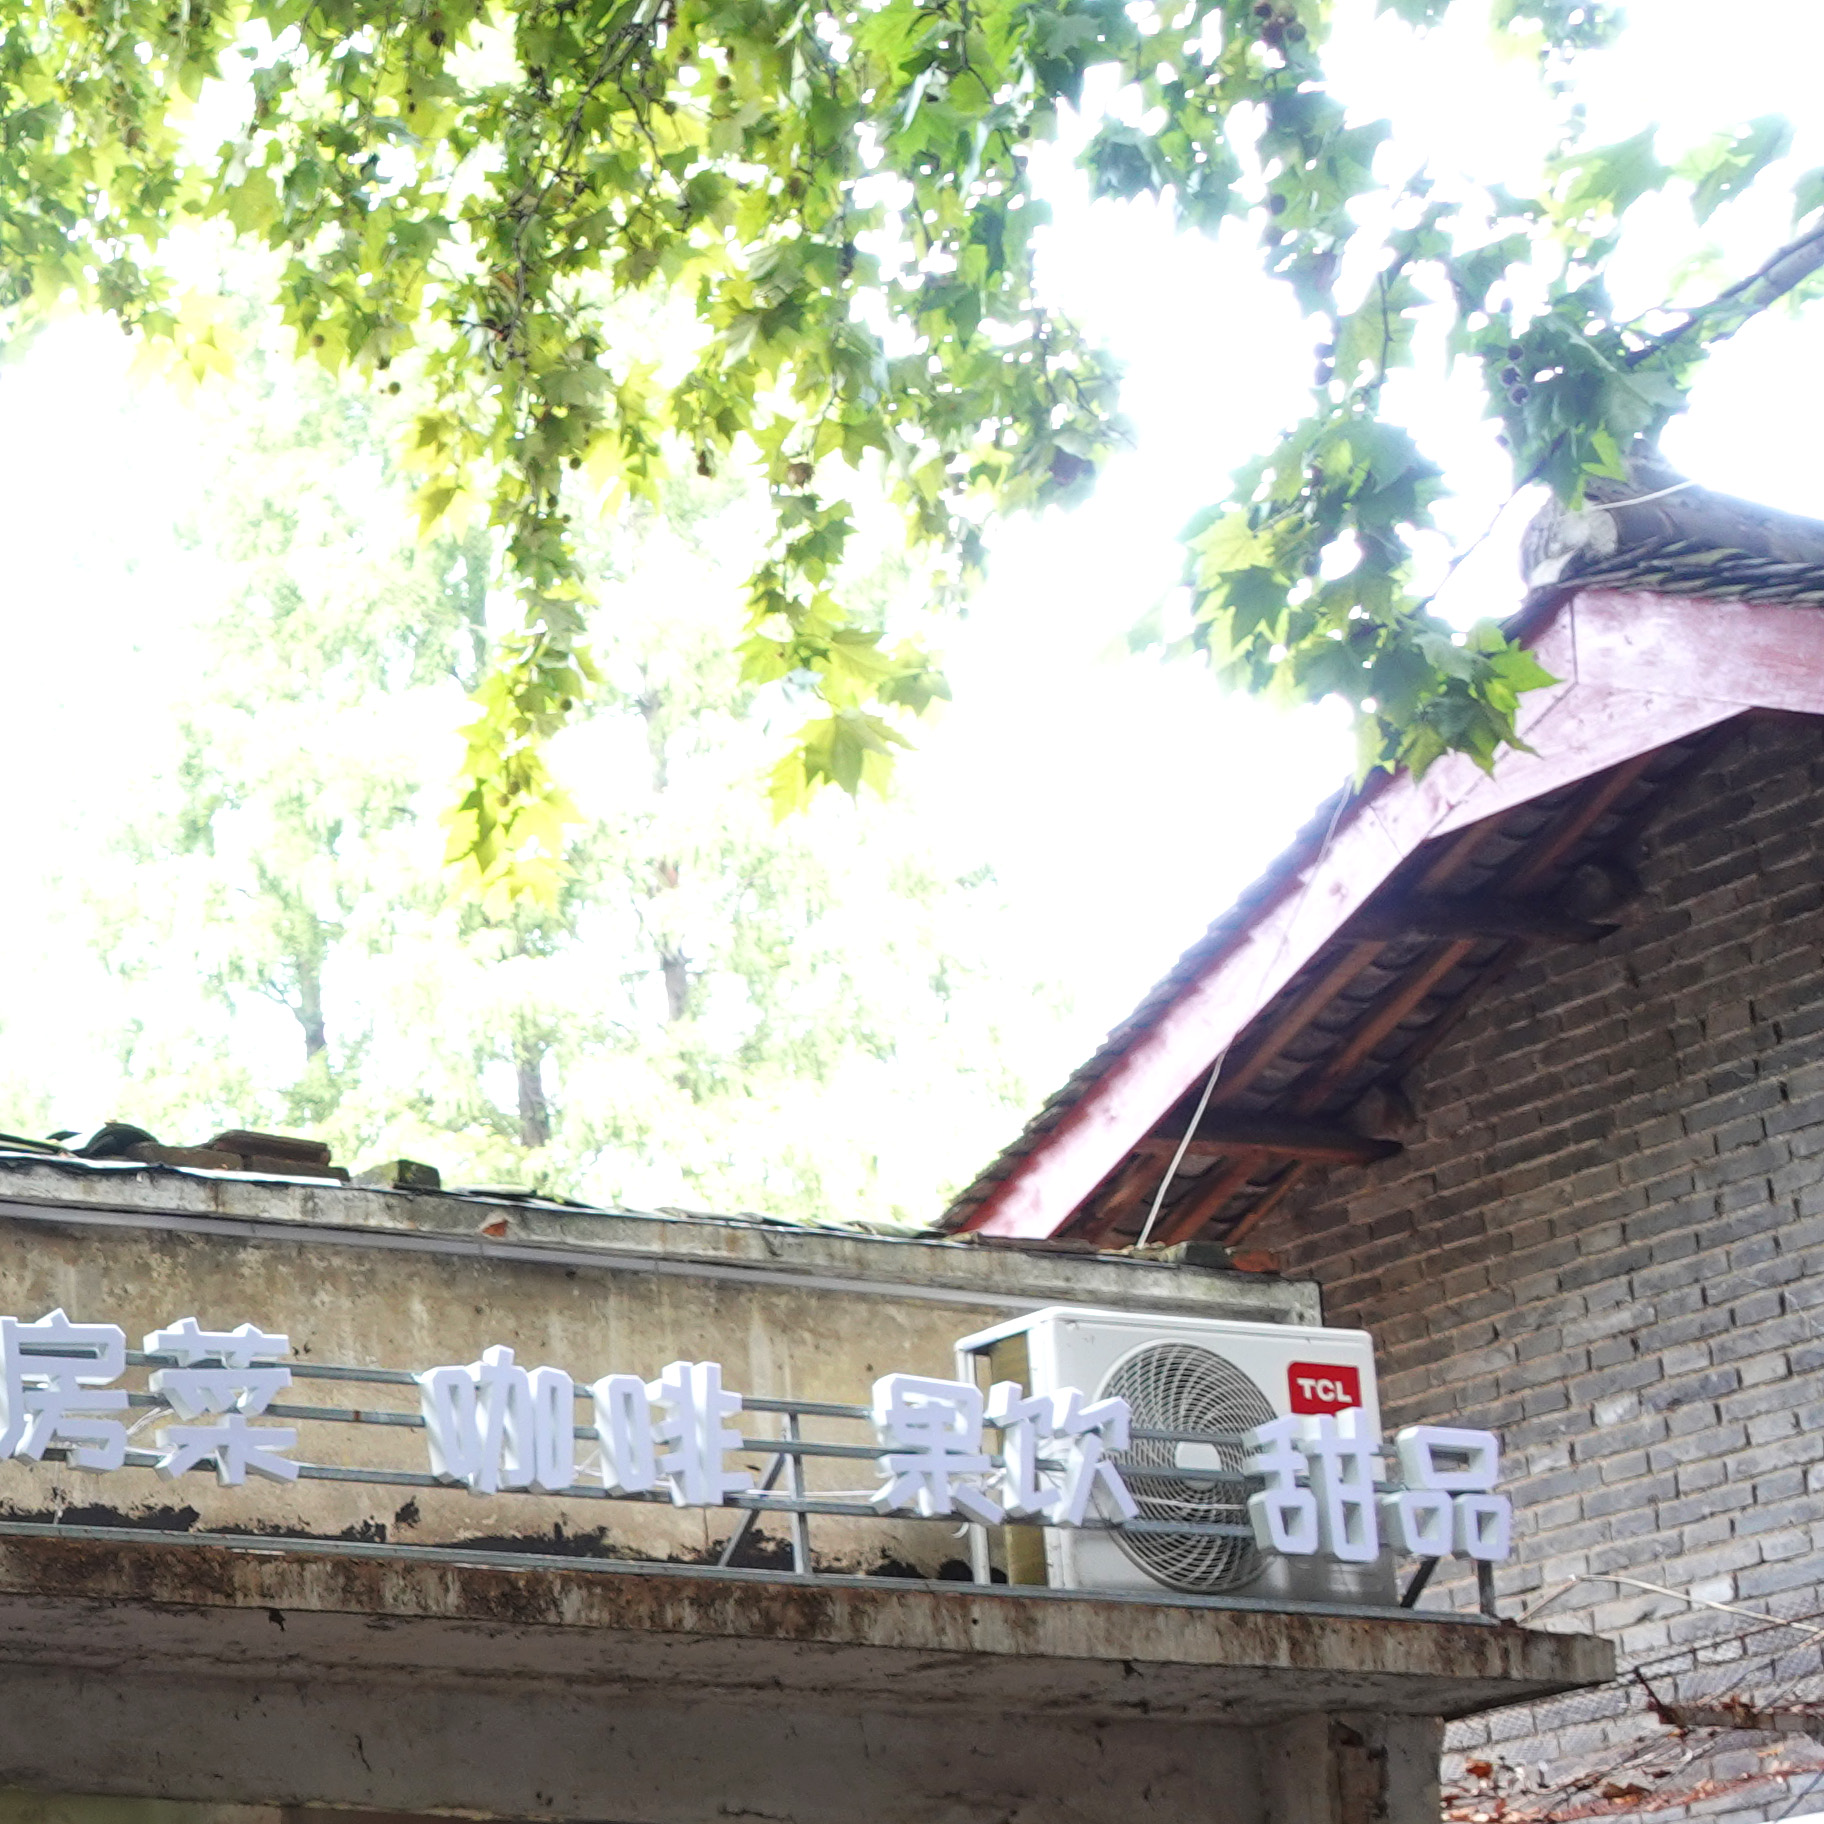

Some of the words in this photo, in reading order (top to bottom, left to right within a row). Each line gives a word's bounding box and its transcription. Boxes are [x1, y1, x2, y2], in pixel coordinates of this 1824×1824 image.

[1297, 1377, 1352, 1404] TCL
[419, 1344, 752, 1508] 咖啡
[870, 1373, 1139, 1528] 果饮
[1243, 1406, 1512, 1562] 甜品
